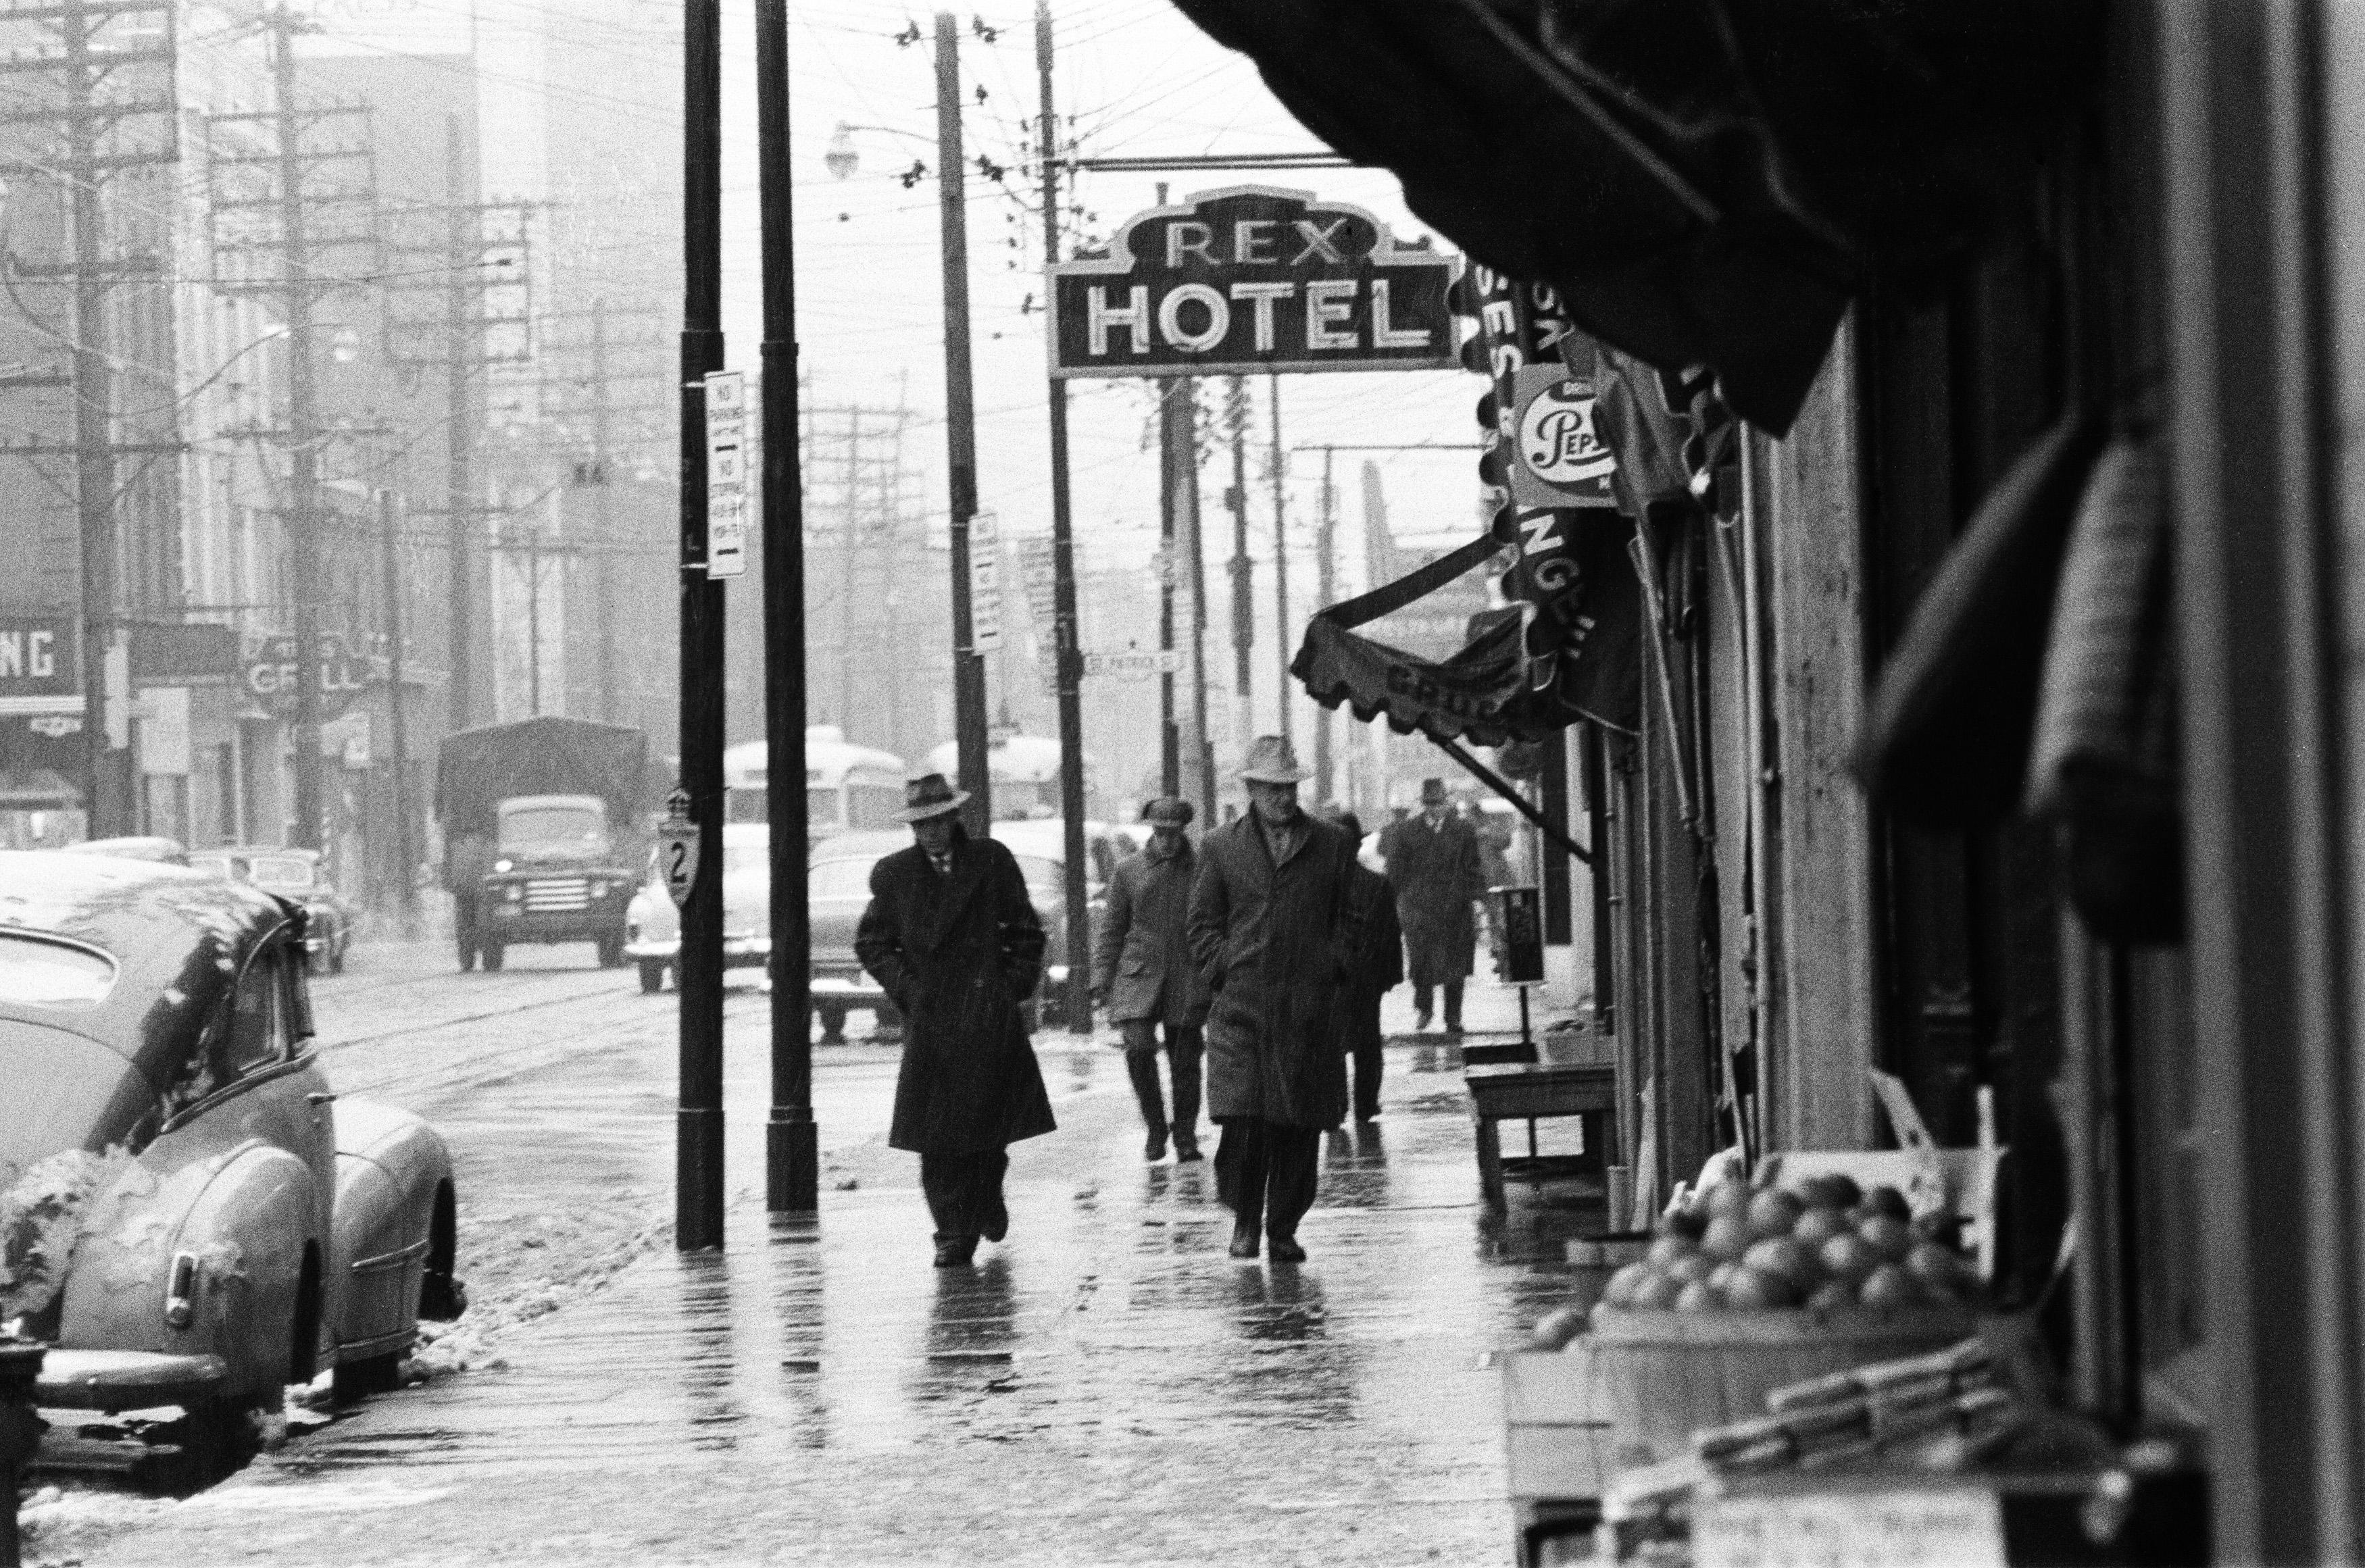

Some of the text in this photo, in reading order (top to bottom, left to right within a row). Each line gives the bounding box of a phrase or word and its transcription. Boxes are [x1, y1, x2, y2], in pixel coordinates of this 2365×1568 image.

[1165, 218, 1350, 269] REX
[1087, 278, 1432, 355] HOTEL
[670, 841, 687, 884] 2
